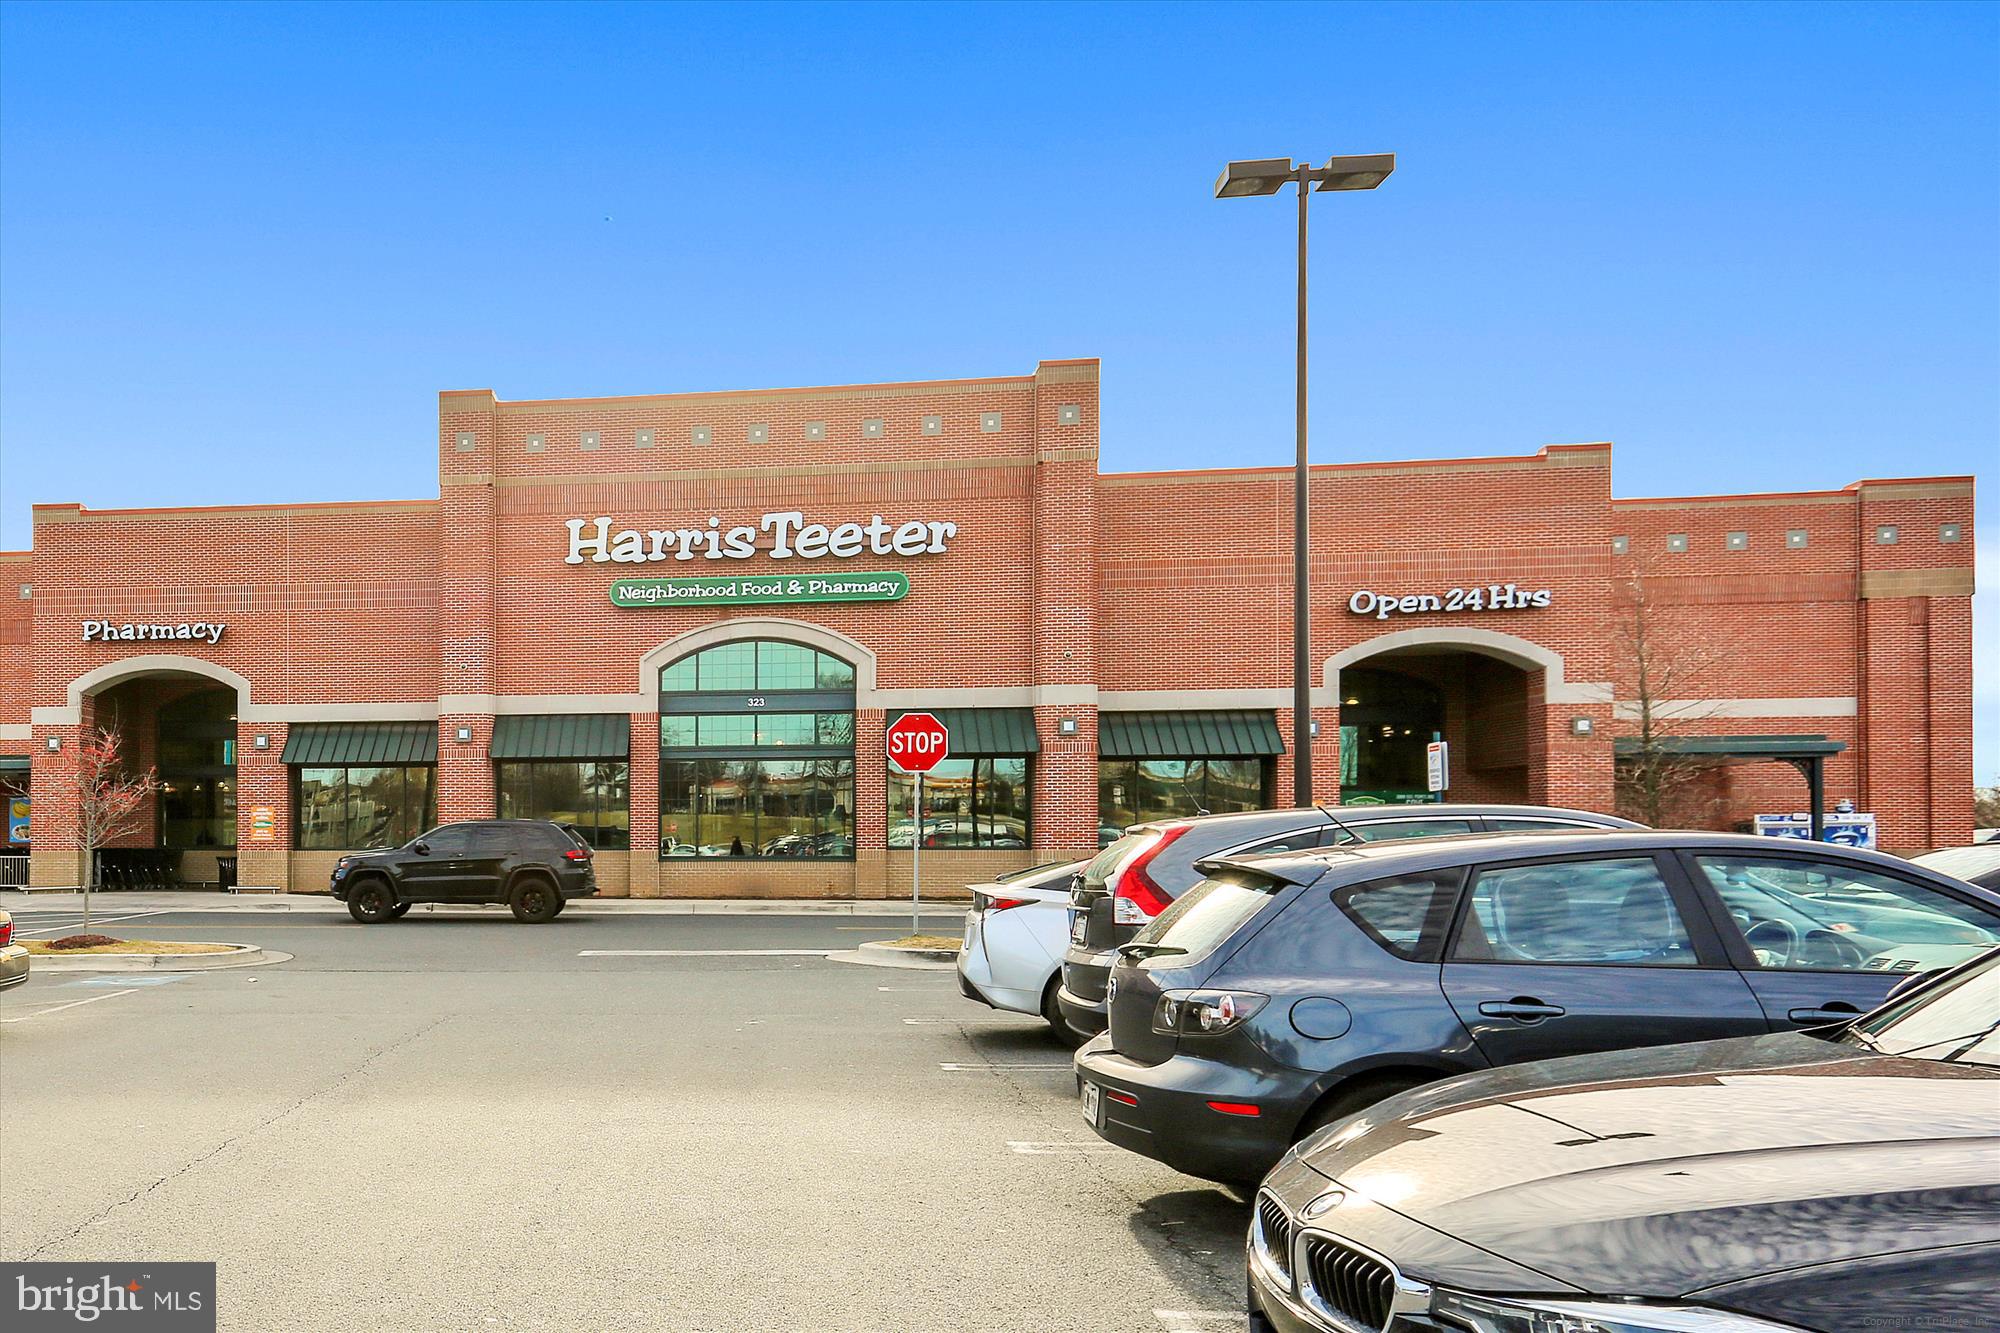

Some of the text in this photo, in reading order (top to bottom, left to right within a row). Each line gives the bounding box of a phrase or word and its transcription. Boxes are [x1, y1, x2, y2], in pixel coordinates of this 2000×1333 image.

[564, 511, 957, 564] Harris Teeter
[618, 579, 901, 603] Neighborhood Food & Pharmacy
[1348, 583, 1552, 620] Open 24 Hrs
[81, 619, 226, 645] Pharmacy
[747, 697, 766, 707] 323
[891, 731, 944, 754] STOP
